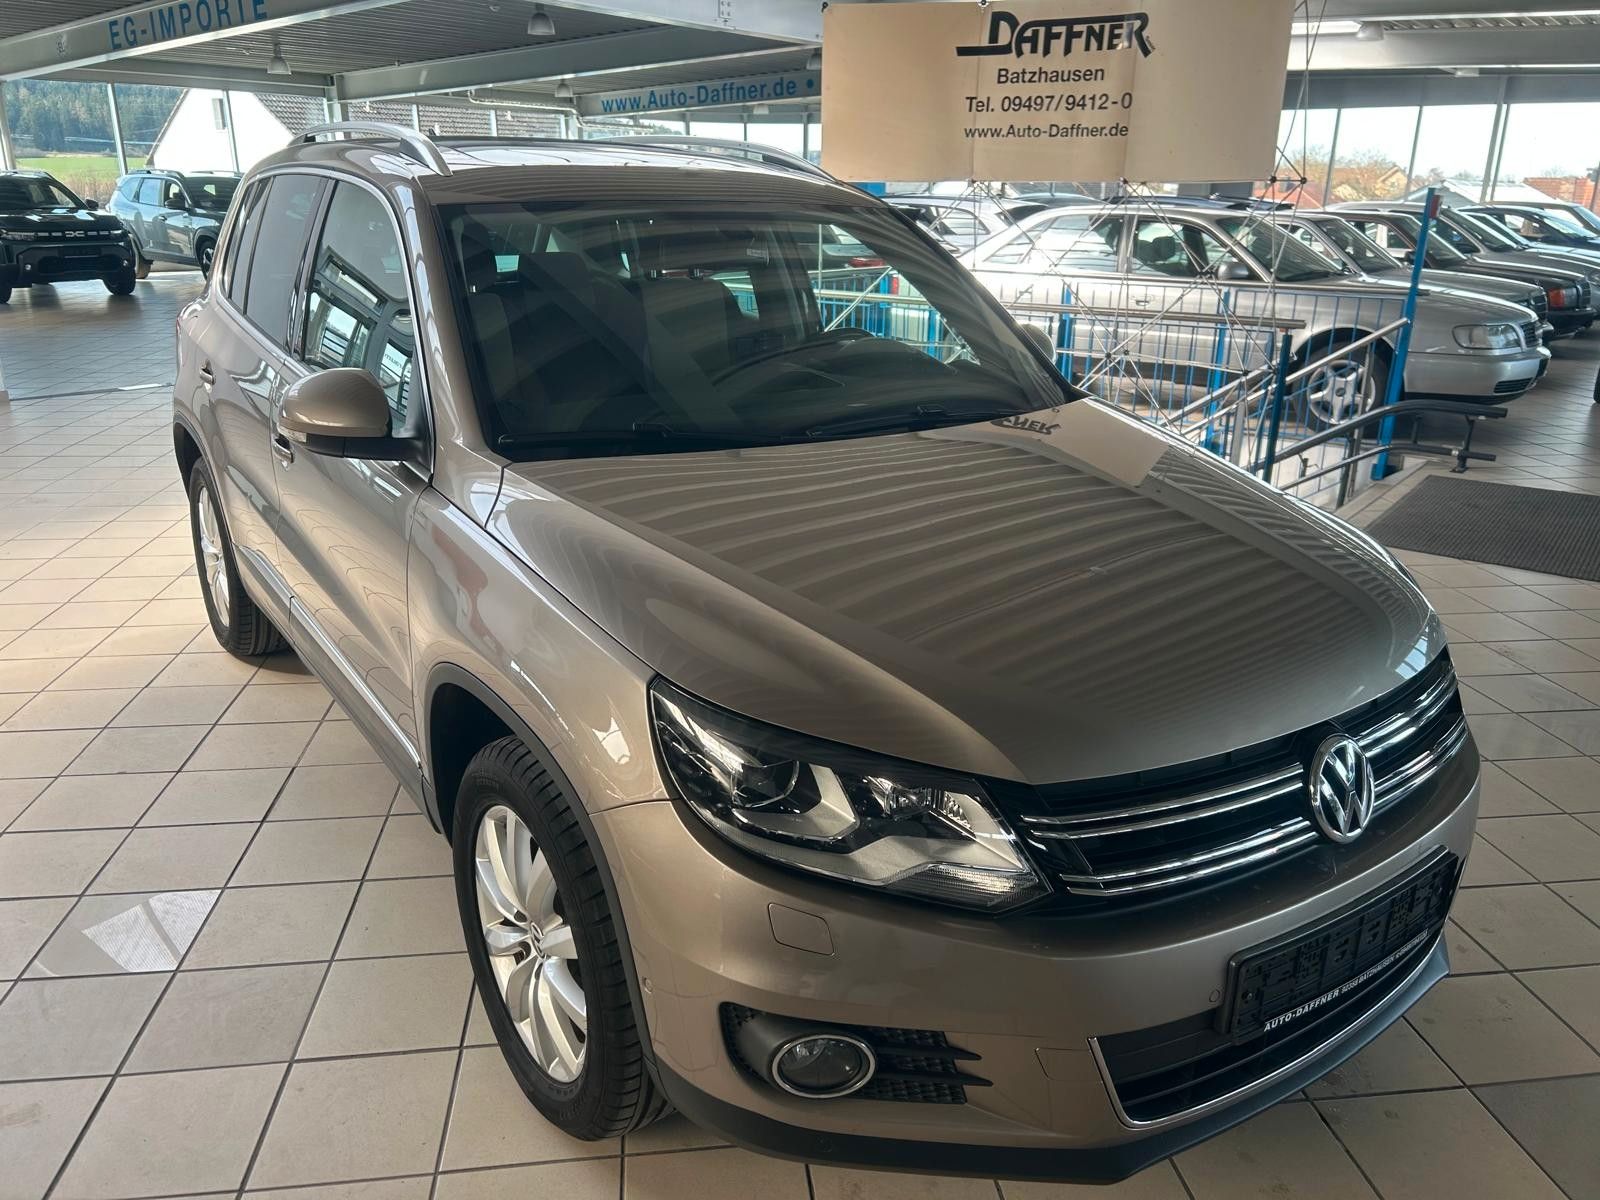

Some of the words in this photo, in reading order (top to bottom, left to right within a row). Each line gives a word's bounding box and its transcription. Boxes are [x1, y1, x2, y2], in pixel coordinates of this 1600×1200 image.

[956, 11, 1152, 58] DAFFNER
[997, 67, 1105, 84] Batzhausen
[602, 77, 797, 113] www.Auto-Daffner.de
[965, 97, 995, 112] Tel.
[1001, 92, 1133, 112] 09497/9412-0
[964, 122, 1129, 138] www.Auto-Daffner.de
